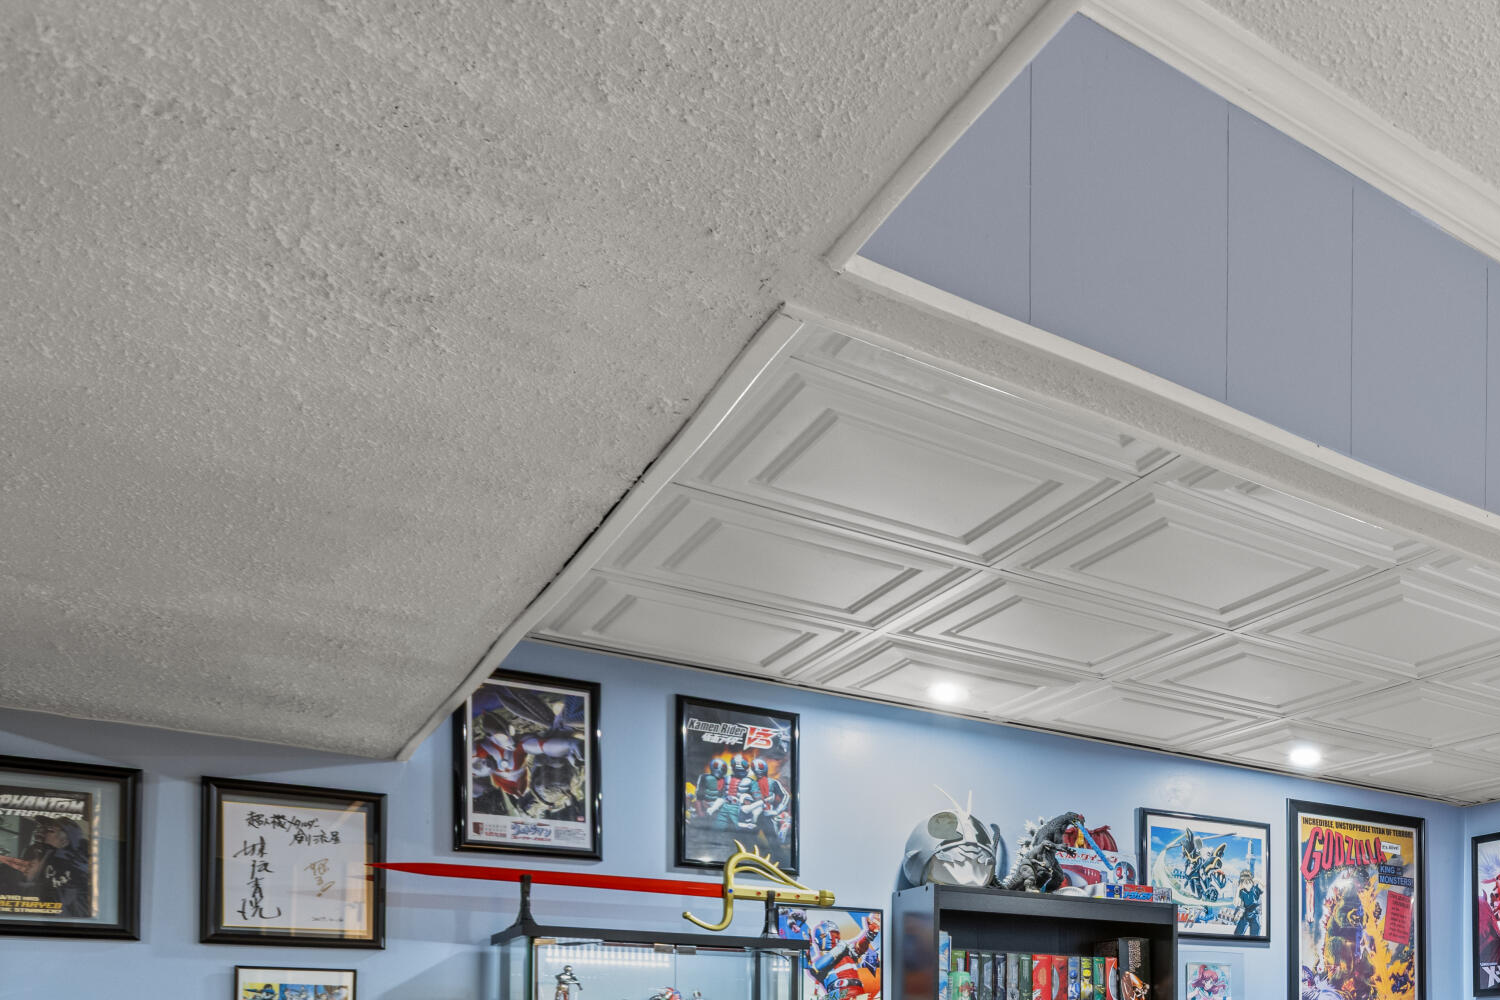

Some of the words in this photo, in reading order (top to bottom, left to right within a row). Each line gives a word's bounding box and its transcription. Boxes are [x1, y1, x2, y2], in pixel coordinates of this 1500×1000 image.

[687, 718, 720, 733] Kamen
[719, 723, 747, 737] Rider
[1335, 821, 1371, 833] UNSTOPPABLE
[1371, 826, 1386, 835] TITAN
[1300, 827, 1388, 881] GODZILLA
[1380, 866, 1396, 874] KING
[1379, 876, 1413, 887] MONSTERS!
